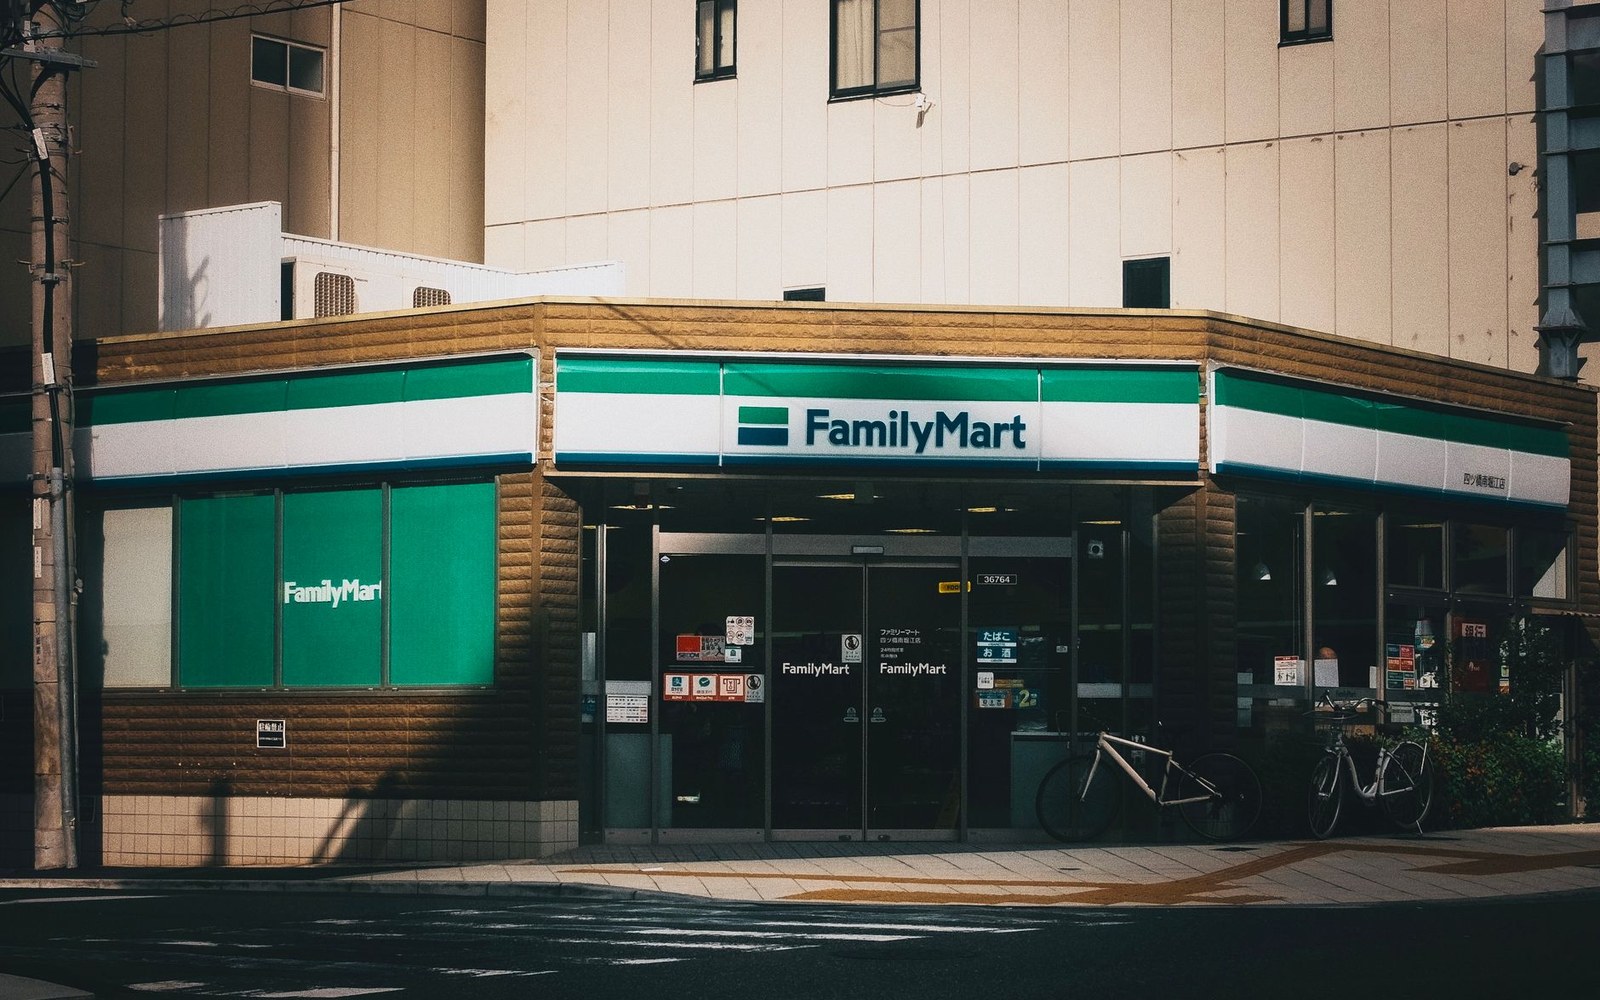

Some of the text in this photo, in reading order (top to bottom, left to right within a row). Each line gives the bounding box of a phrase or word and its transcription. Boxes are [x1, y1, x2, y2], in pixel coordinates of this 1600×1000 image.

[806, 409, 1026, 453] FamilyMart
[984, 575, 1010, 583] 36764
[983, 631, 1011, 641] たばこ
[782, 662, 850, 677] FamilyMart
[880, 662, 946, 677] FamilyMart
